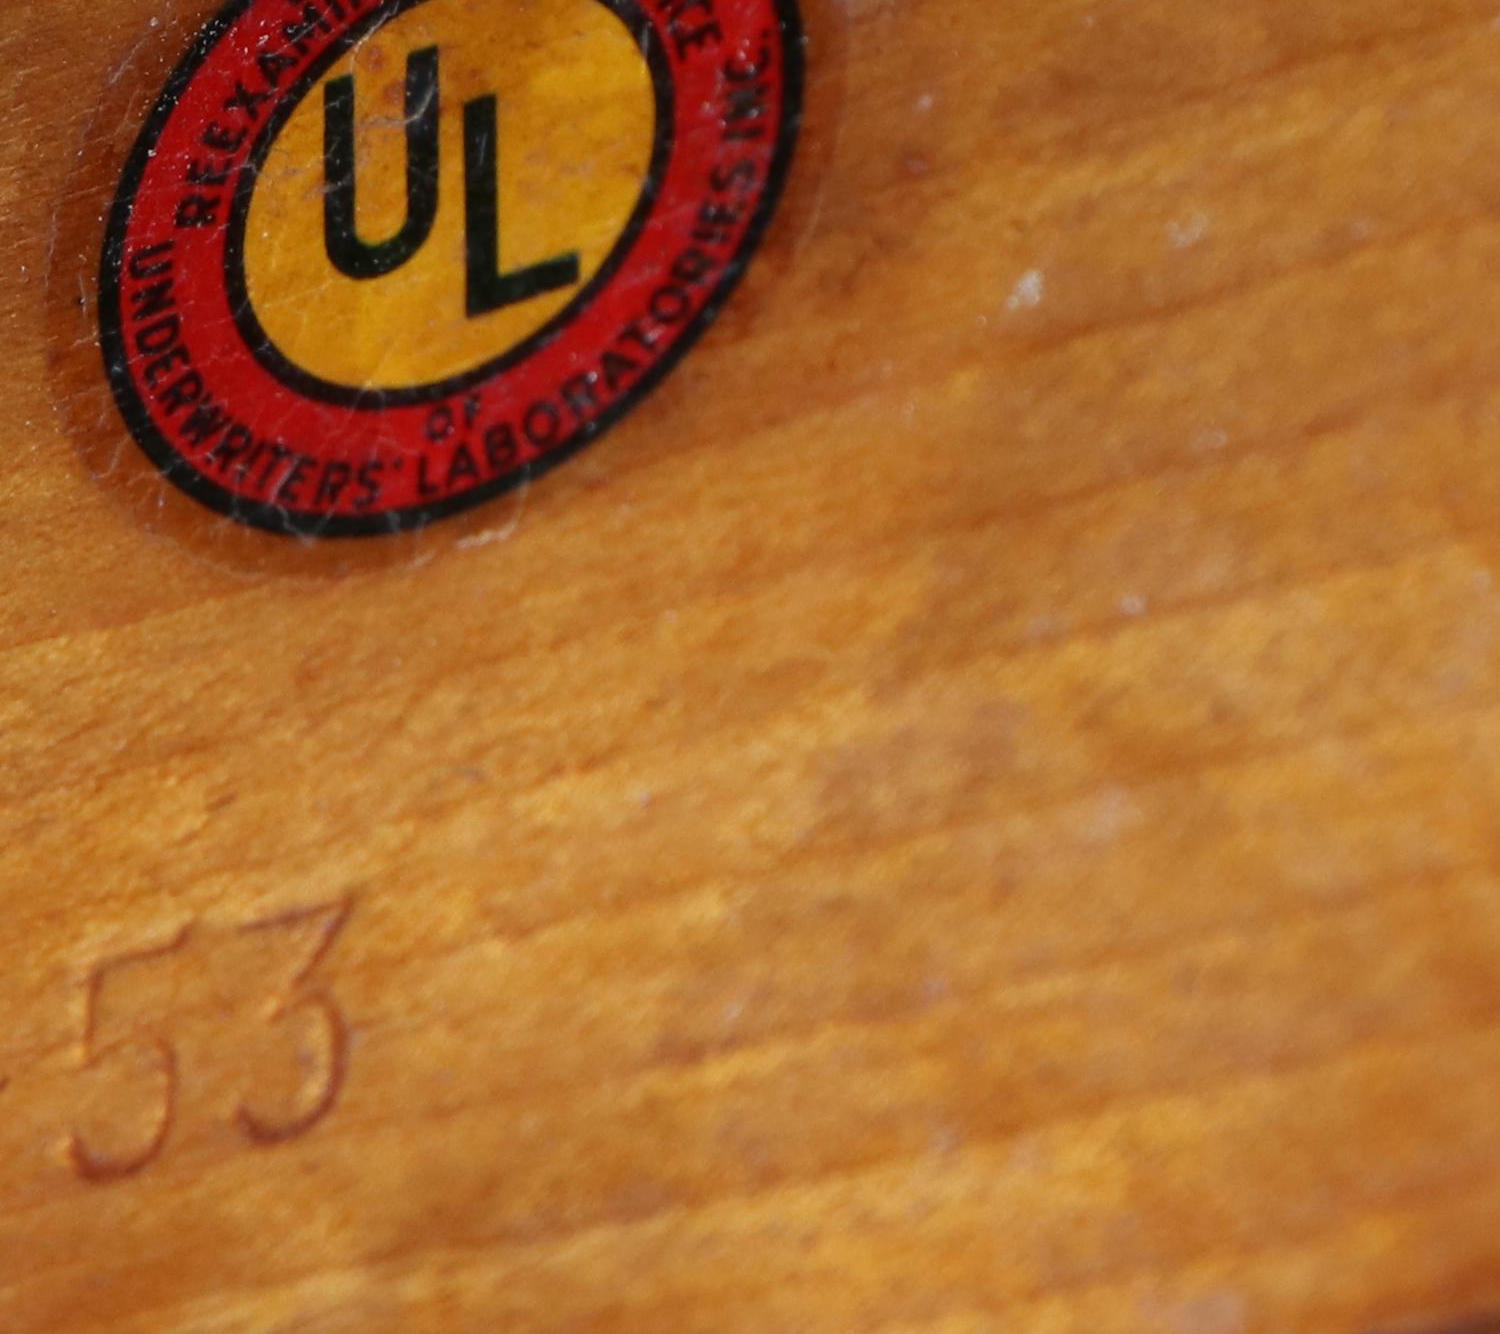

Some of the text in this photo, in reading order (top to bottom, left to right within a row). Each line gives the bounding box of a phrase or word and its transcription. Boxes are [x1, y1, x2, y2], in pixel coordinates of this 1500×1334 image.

[323, 43, 580, 318] UL
[417, 158, 759, 496] LABORATORIES
[424, 393, 482, 444] OF
